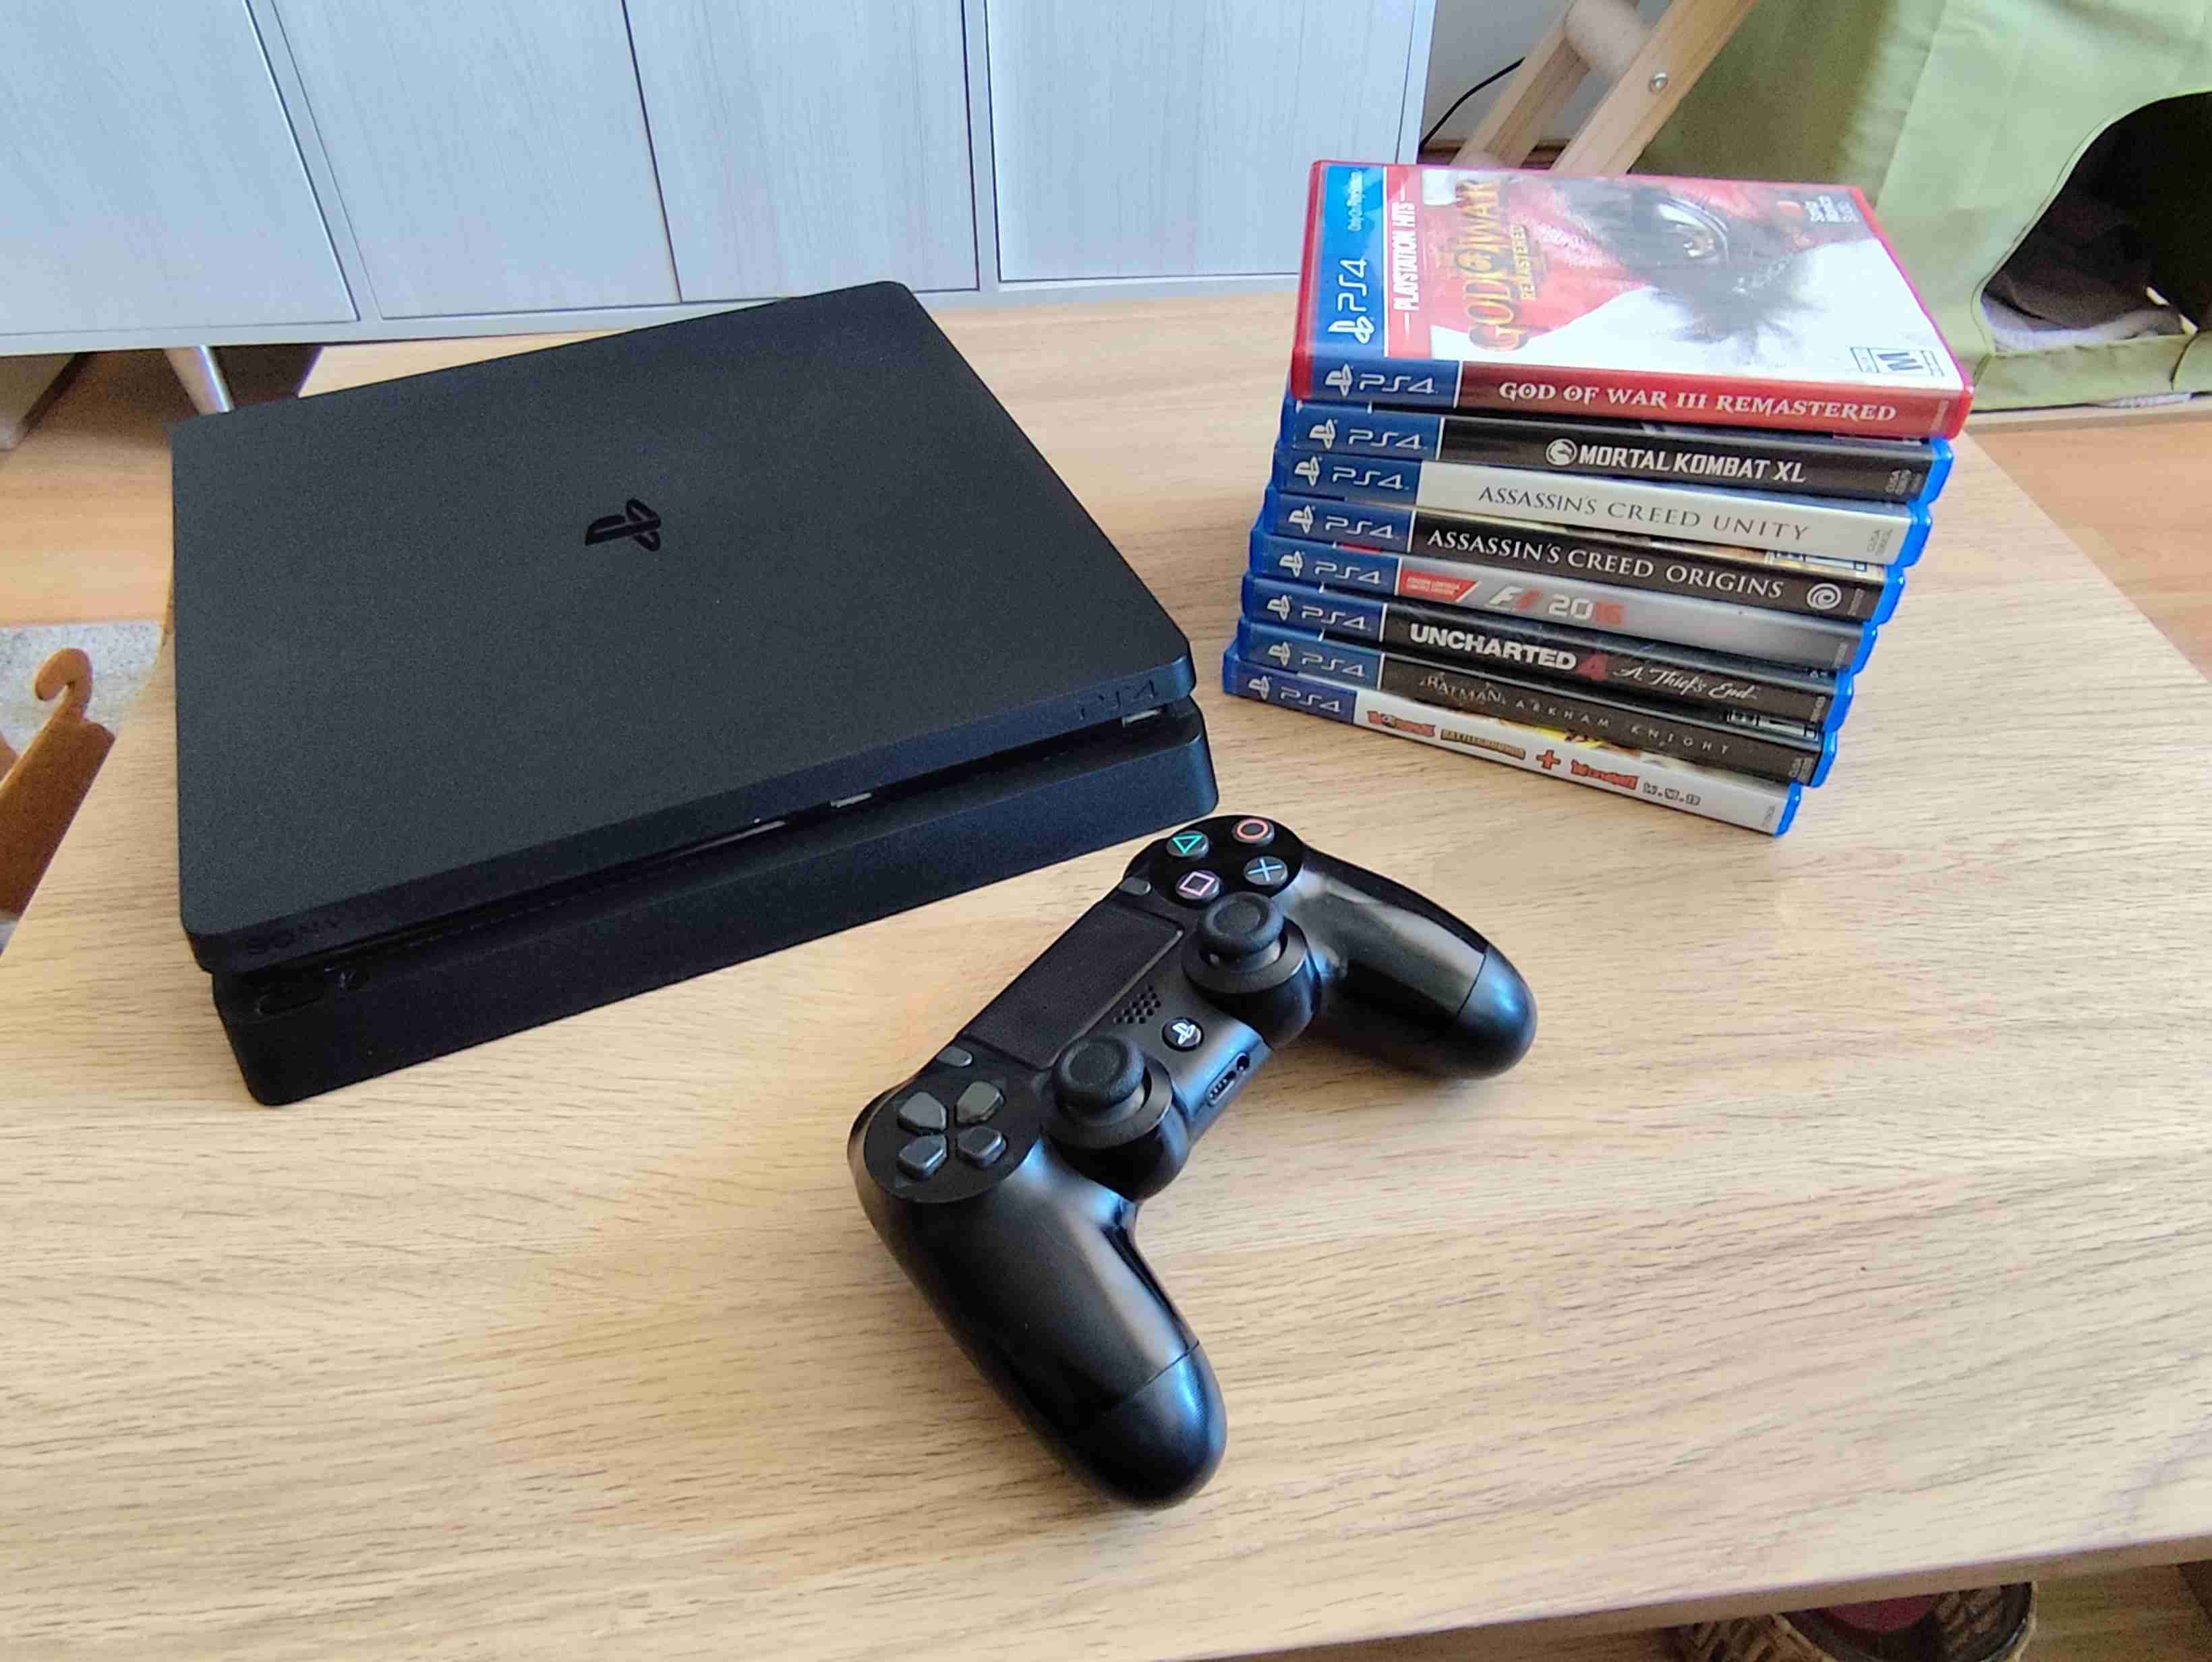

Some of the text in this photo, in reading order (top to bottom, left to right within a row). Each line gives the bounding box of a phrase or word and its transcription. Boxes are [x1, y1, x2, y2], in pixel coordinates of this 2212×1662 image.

[1337, 258, 1368, 312] PS4
[1391, 202, 1420, 312] PLAYSTATION HITS
[1467, 281, 1528, 351] GOD
[1877, 352, 1923, 372] M
[1359, 373, 1897, 422] PS4 GOD OF WAR III REMASTERED
[1349, 429, 1807, 484] PS4 MORTAL KOMBAT XL
[1332, 467, 1811, 542] PS4 ASSASSIN'S CREED UNITY
[1314, 562, 1382, 585] PS4
[1325, 517, 1784, 599] PS4 ASSASSIN'S CREED ORIGINS
[1302, 606, 1757, 700] PS4 UNCHARTED 4 A Thief's End
[1281, 687, 1341, 714] PS4
[1302, 653, 1366, 679] PS4
[1515, 699, 1610, 728] ARKHAM
[1631, 723, 1730, 755] KNIGHT
